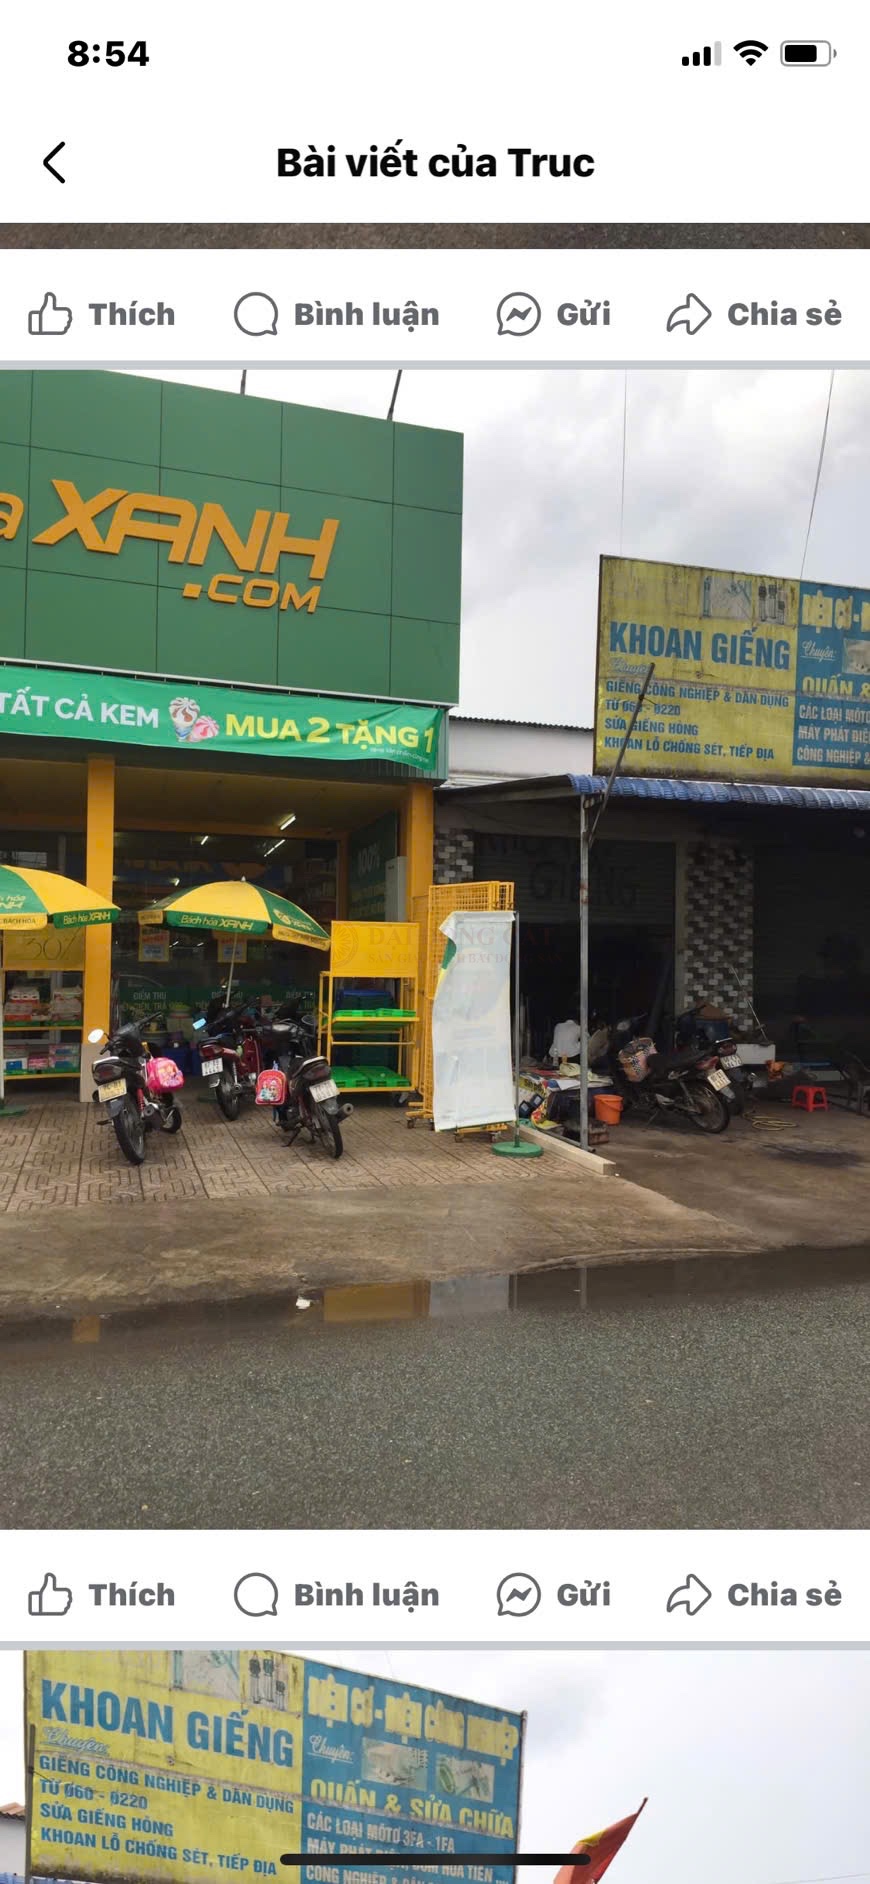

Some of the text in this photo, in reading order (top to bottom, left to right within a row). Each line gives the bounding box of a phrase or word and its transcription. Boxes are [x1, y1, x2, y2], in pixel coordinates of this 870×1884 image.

[67, 39, 150, 68] 8:54
[277, 138, 595, 178] Bài viết của Truc
[88, 300, 175, 326] Thích
[294, 300, 439, 333] Bình luận
[556, 298, 611, 327] Gửi
[727, 298, 842, 327] Chia sẻ
[32, 479, 340, 580] XANH
[183, 573, 322, 613] .COM
[609, 621, 791, 670] KHOAN GIẾNG
[723, 691, 732, 703] &
[760, 693, 790, 708] DỤNG
[798, 702, 818, 720] CÁC
[0, 686, 435, 754] TẤT CẢ KEM MUA 2 TẶNG 1
[798, 723, 820, 740] MÁY
[823, 725, 850, 742] PHÁT
[663, 738, 701, 754] CHỐNG
[729, 743, 753, 759] TIẾP
[756, 747, 775, 762] ĐỊA
[796, 745, 823, 762] CÔNG
[180, 914, 254, 931] Bách hóa XANH
[88, 1580, 175, 1606] Thích
[294, 1580, 439, 1613] Bình luận
[556, 1578, 611, 1607] Gửi
[727, 1578, 842, 1607] Chia sẻ
[41, 1678, 294, 1768] KHOAN GIẾNG
[95, 1763, 139, 1785] CÔNG
[144, 1772, 202, 1798] NGHIỆP
[206, 1785, 217, 1801] &
[222, 1787, 252, 1806] DÂN
[256, 1795, 294, 1814] DỤNG
[39, 1800, 73, 1822] SỬA
[77, 1806, 127, 1830] GIẾNG
[386, 1794, 401, 1815] &
[409, 1793, 453, 1825] SỬA
[459, 1807, 514, 1839] CHỮA
[307, 1810, 332, 1833] CÁC
[335, 1817, 363, 1841] LOẠI
[403, 1829, 425, 1849] 3FA
[435, 1836, 455, 1854] 1FA
[40, 1827, 97, 1849] KHOAN
[101, 1832, 121, 1852] LỖ
[125, 1838, 178, 1861] CHỐNG
[216, 1852, 250, 1872] TIẾP
[253, 1859, 278, 1877] ĐỊA
